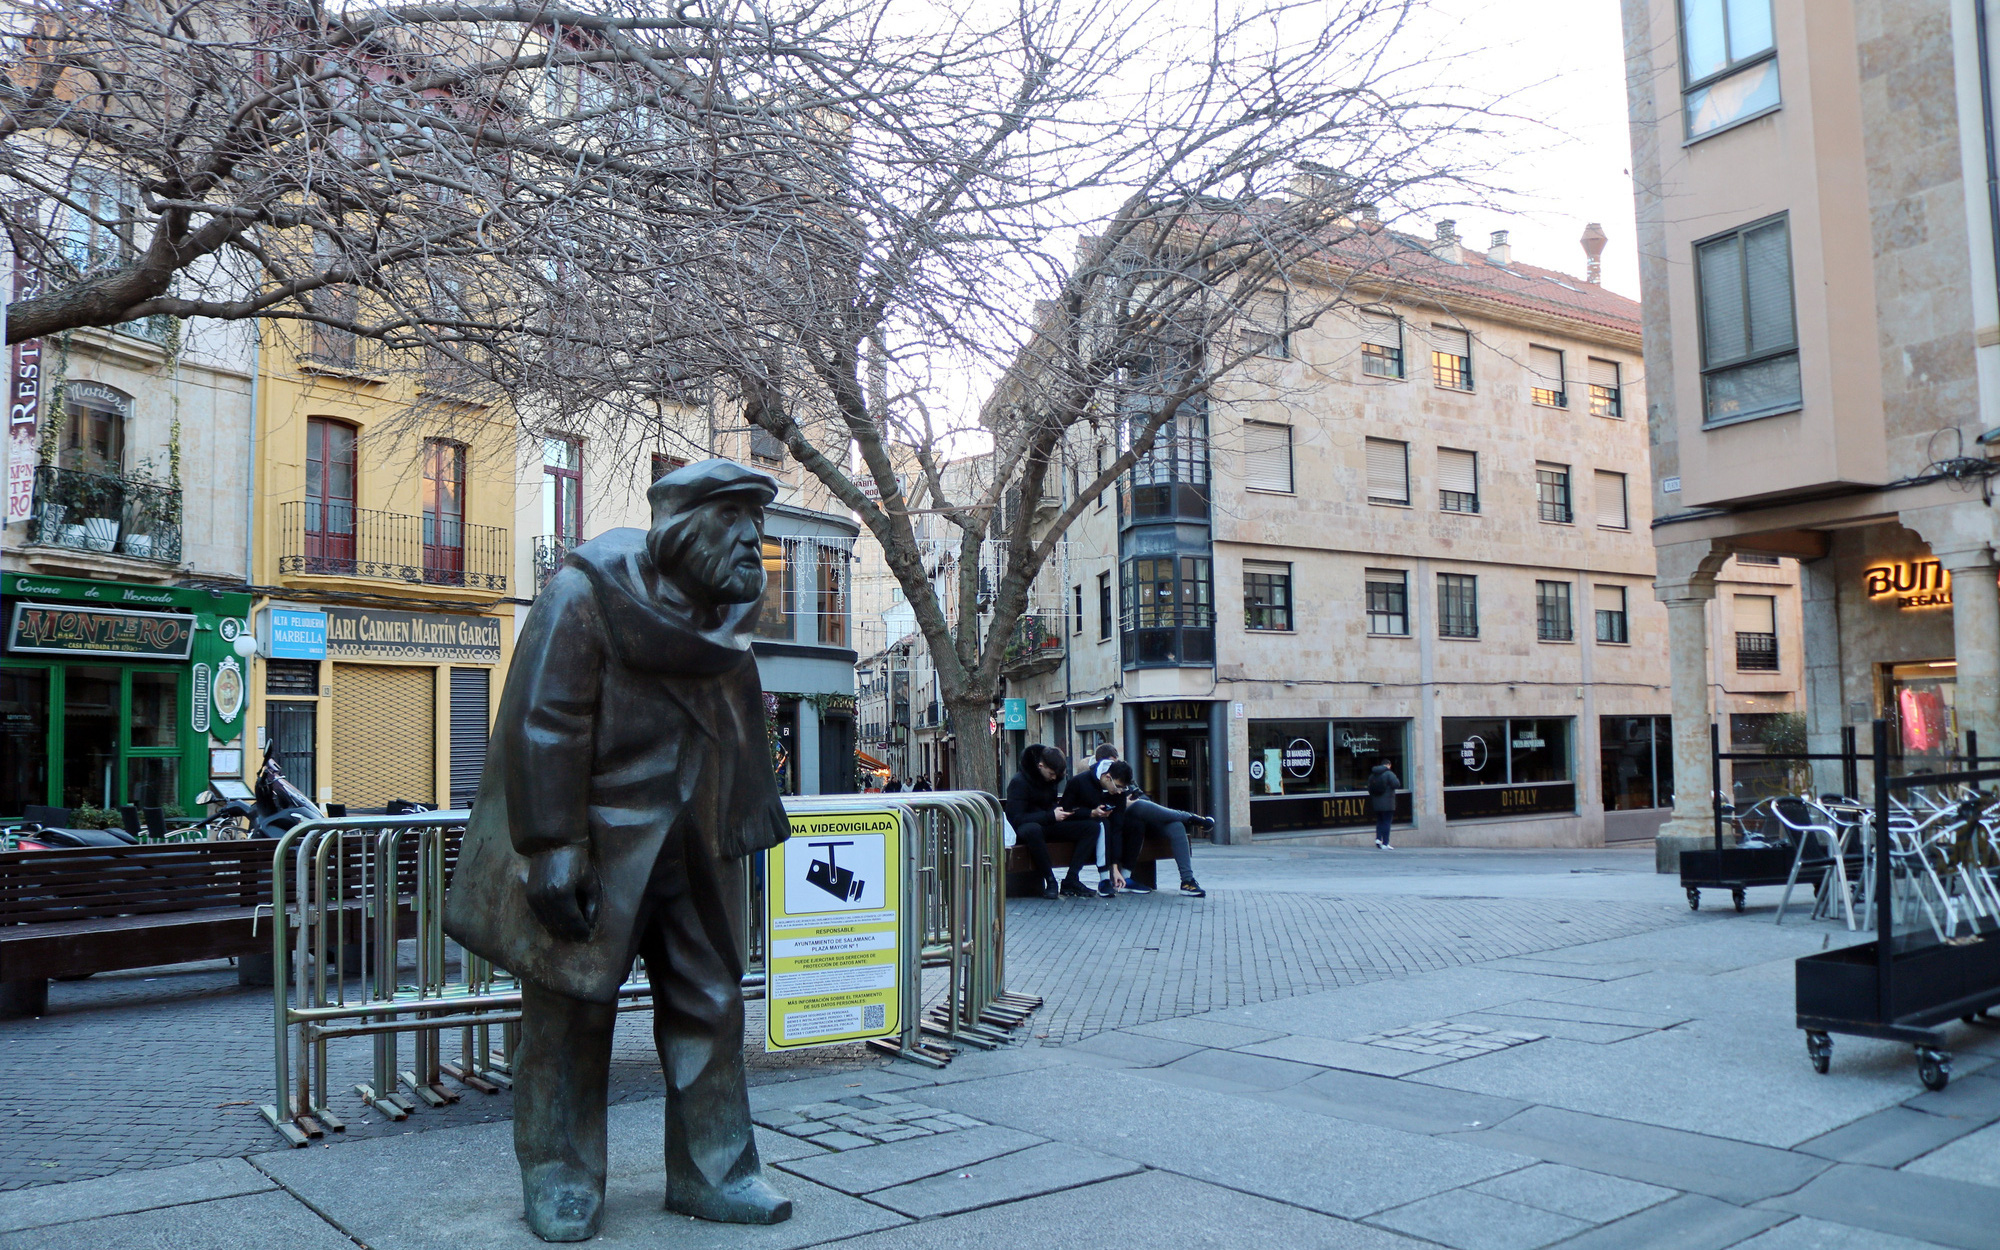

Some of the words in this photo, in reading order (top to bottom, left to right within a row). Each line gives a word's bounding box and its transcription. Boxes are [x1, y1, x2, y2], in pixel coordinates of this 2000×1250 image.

[67, 382, 128, 413] Montero
[16, 578, 62, 594] Cocina
[84, 587, 100, 598] de
[122, 589, 174, 603] Mercado
[274, 615, 288, 626] ALTA
[22, 610, 180, 650] MONTERO
[274, 630, 323, 644] MARBELLA
[326, 613, 356, 641] MARI
[359, 615, 409, 643] CARMEN
[412, 617, 456, 645] MARTÍN
[458, 620, 500, 647] GARCÍA
[430, 647, 500, 661] IBERICOS
[810, 822, 893, 832] VIDEOVIGILADA
[798, 997, 829, 1005] INFORMACIÓN
